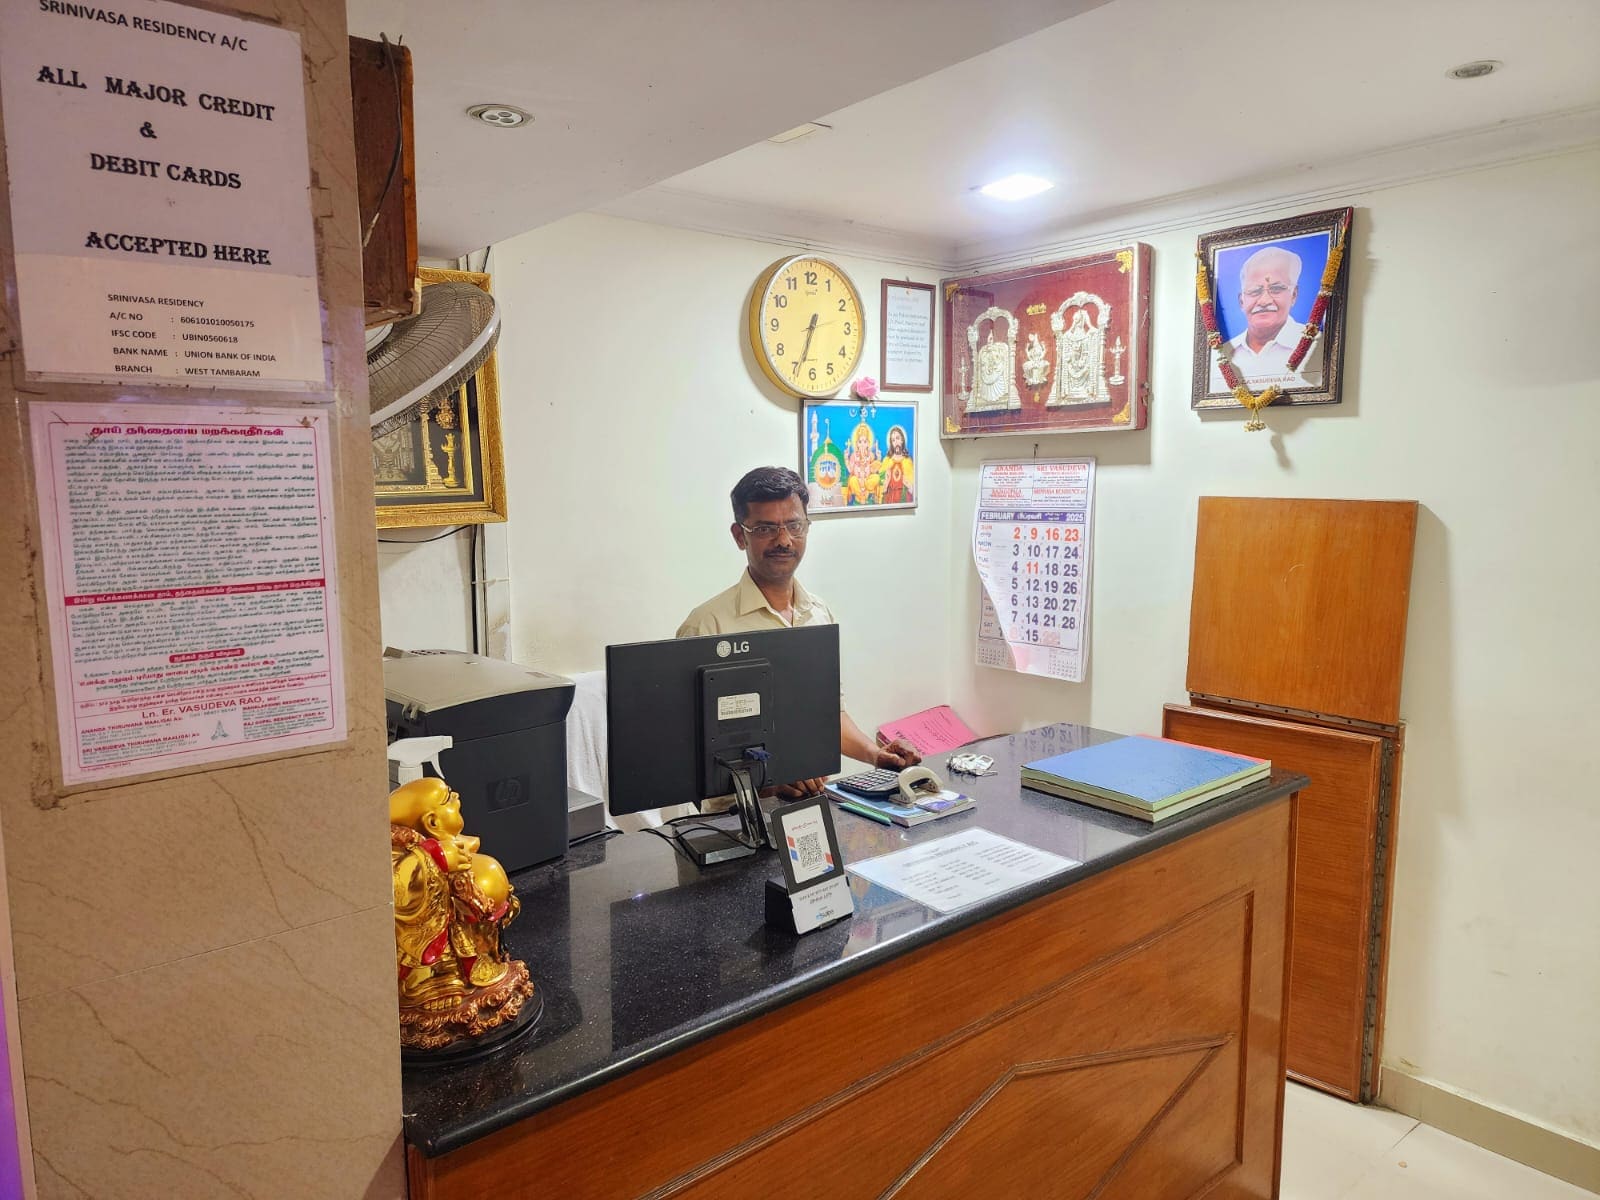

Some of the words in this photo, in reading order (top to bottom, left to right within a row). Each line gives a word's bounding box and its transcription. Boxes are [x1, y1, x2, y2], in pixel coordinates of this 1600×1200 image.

[39, 0, 128, 27] SRINIVASA
[133, 16, 216, 44] RESIDENCY
[221, 35, 248, 51] A/C
[36, 65, 87, 89] ALL
[105, 76, 188, 107] MAJOR
[198, 93, 275, 121] CREDIT
[140, 121, 157, 139] &
[90, 153, 160, 178] DEBIT
[167, 164, 242, 189] CARDS
[85, 231, 207, 259] ACCEPTED
[213, 244, 271, 266] HERE
[786, 277, 797, 290] 11
[804, 272, 817, 285] 12
[825, 280, 831, 292] 1
[107, 294, 156, 306] SRINIVASA
[158, 297, 204, 308] RESIDENCY
[773, 295, 787, 308] 10
[839, 299, 846, 311] 2
[110, 312, 127, 321] A/C
[129, 313, 143, 321] NO
[771, 318, 779, 331] 9
[844, 323, 851, 335] 3
[111, 330, 130, 338] IFSC
[132, 331, 157, 339] CODE
[113, 347, 139, 356] BANK
[140, 348, 168, 357] NAME
[184, 350, 213, 360] UNION
[215, 352, 239, 361] BANK
[240, 353, 251, 361] OF
[253, 354, 277, 363] INDIA
[776, 343, 784, 356] 8
[838, 346, 846, 358] 4
[115, 364, 153, 374] BRANCH
[185, 367, 208, 377] WEST
[210, 368, 261, 378] TAMBARAM
[792, 362, 799, 374] 7
[809, 368, 816, 380] 6
[827, 363, 834, 375] 5
[981, 512, 1014, 520] FEBRUARY
[1014, 527, 1020, 539] 2
[1031, 528, 1037, 540] 9
[1046, 528, 1059, 541] 16
[1064, 529, 1079, 541] 23
[1013, 544, 1019, 556] 3
[1028, 545, 1040, 557] 10
[1046, 546, 1059, 558] 17
[1064, 547, 1078, 559] 24
[1012, 561, 1018, 573] 4
[1026, 561, 1038, 574] 11
[1045, 563, 1058, 576] 18
[1064, 564, 1078, 577] 25
[1012, 578, 1018, 590] 5
[1026, 579, 1039, 591] 12
[1044, 581, 1058, 593] 19
[1063, 582, 1077, 594] 26
[1011, 594, 1018, 606] 6
[1026, 596, 1039, 608] 13
[1044, 598, 1058, 610] 20
[1062, 599, 1077, 612] 27
[1012, 611, 1018, 623] 7
[1026, 613, 1038, 625] 14
[1044, 615, 1056, 627] 21
[1062, 617, 1076, 629] 28
[1026, 630, 1038, 642] 15
[734, 641, 749, 653] LG
[142, 711, 159, 719] Ln.
[162, 708, 176, 716] Er.
[179, 699, 236, 713] VASUDEVA
[240, 696, 264, 706] RAO,
